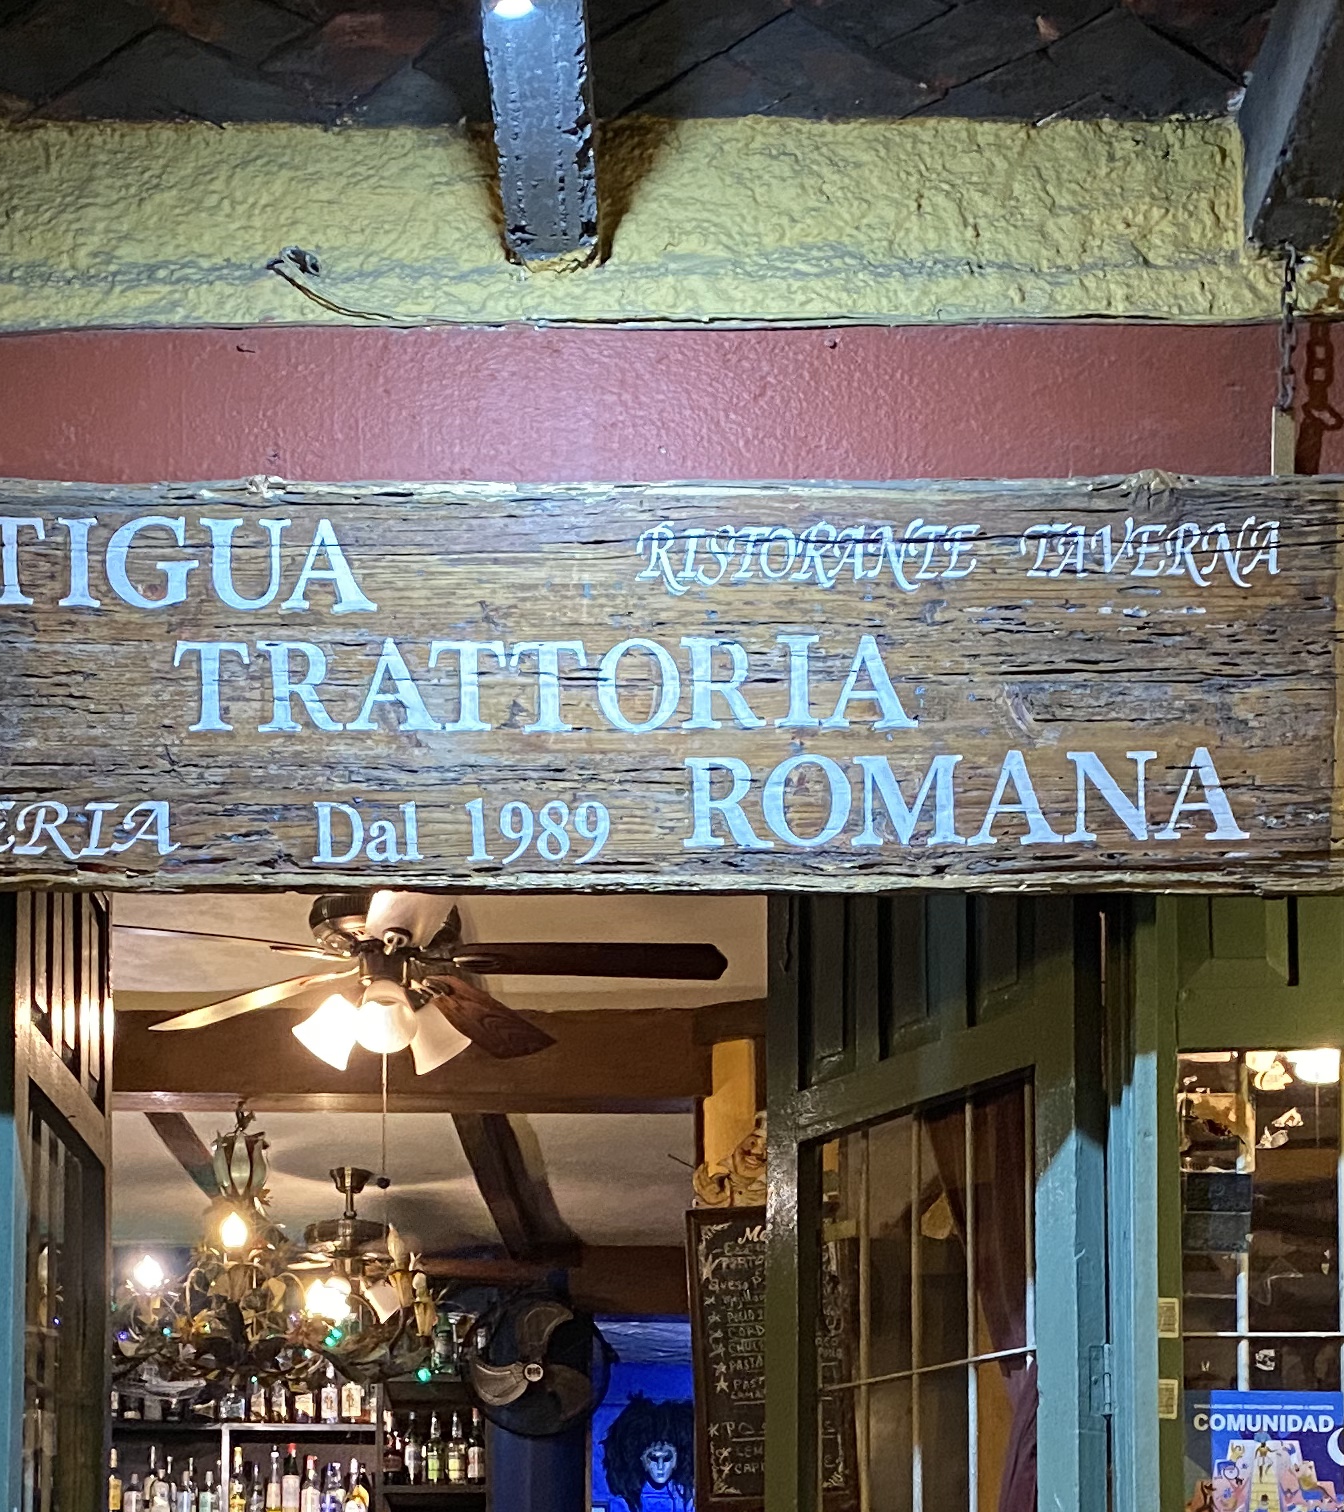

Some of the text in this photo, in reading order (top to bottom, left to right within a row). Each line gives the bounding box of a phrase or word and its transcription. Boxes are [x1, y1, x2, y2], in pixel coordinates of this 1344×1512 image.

[635, 516, 1281, 595] RISTORANTE TAVERNA
[173, 634, 920, 733] TRATTORIA
[312, 799, 610, 865] Dal 1989
[683, 746, 1250, 849] ROMANA
[1193, 1413, 1335, 1433] COMUNIDAD
